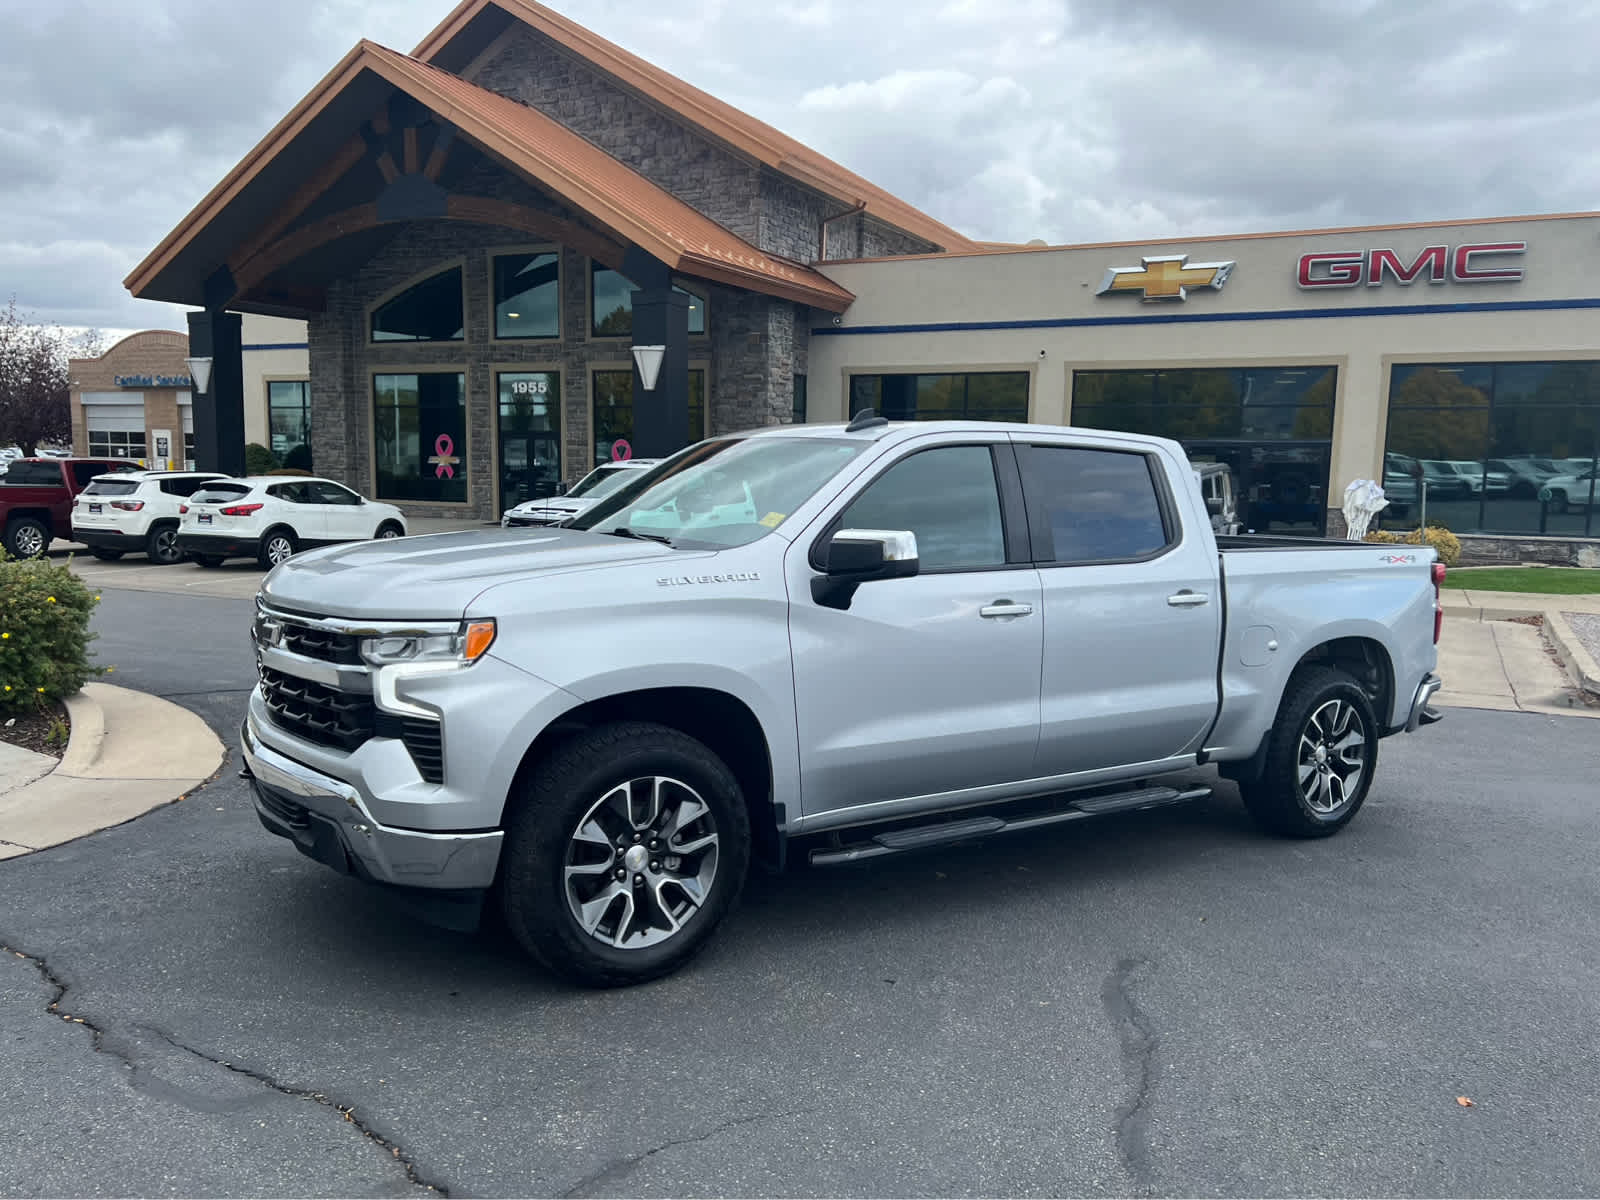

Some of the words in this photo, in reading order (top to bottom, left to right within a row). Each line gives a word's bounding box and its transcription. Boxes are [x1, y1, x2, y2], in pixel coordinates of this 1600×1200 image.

[1297, 241, 1527, 289] GMC
[511, 381, 547, 393] 1955
[656, 572, 761, 587] SILVERADO
